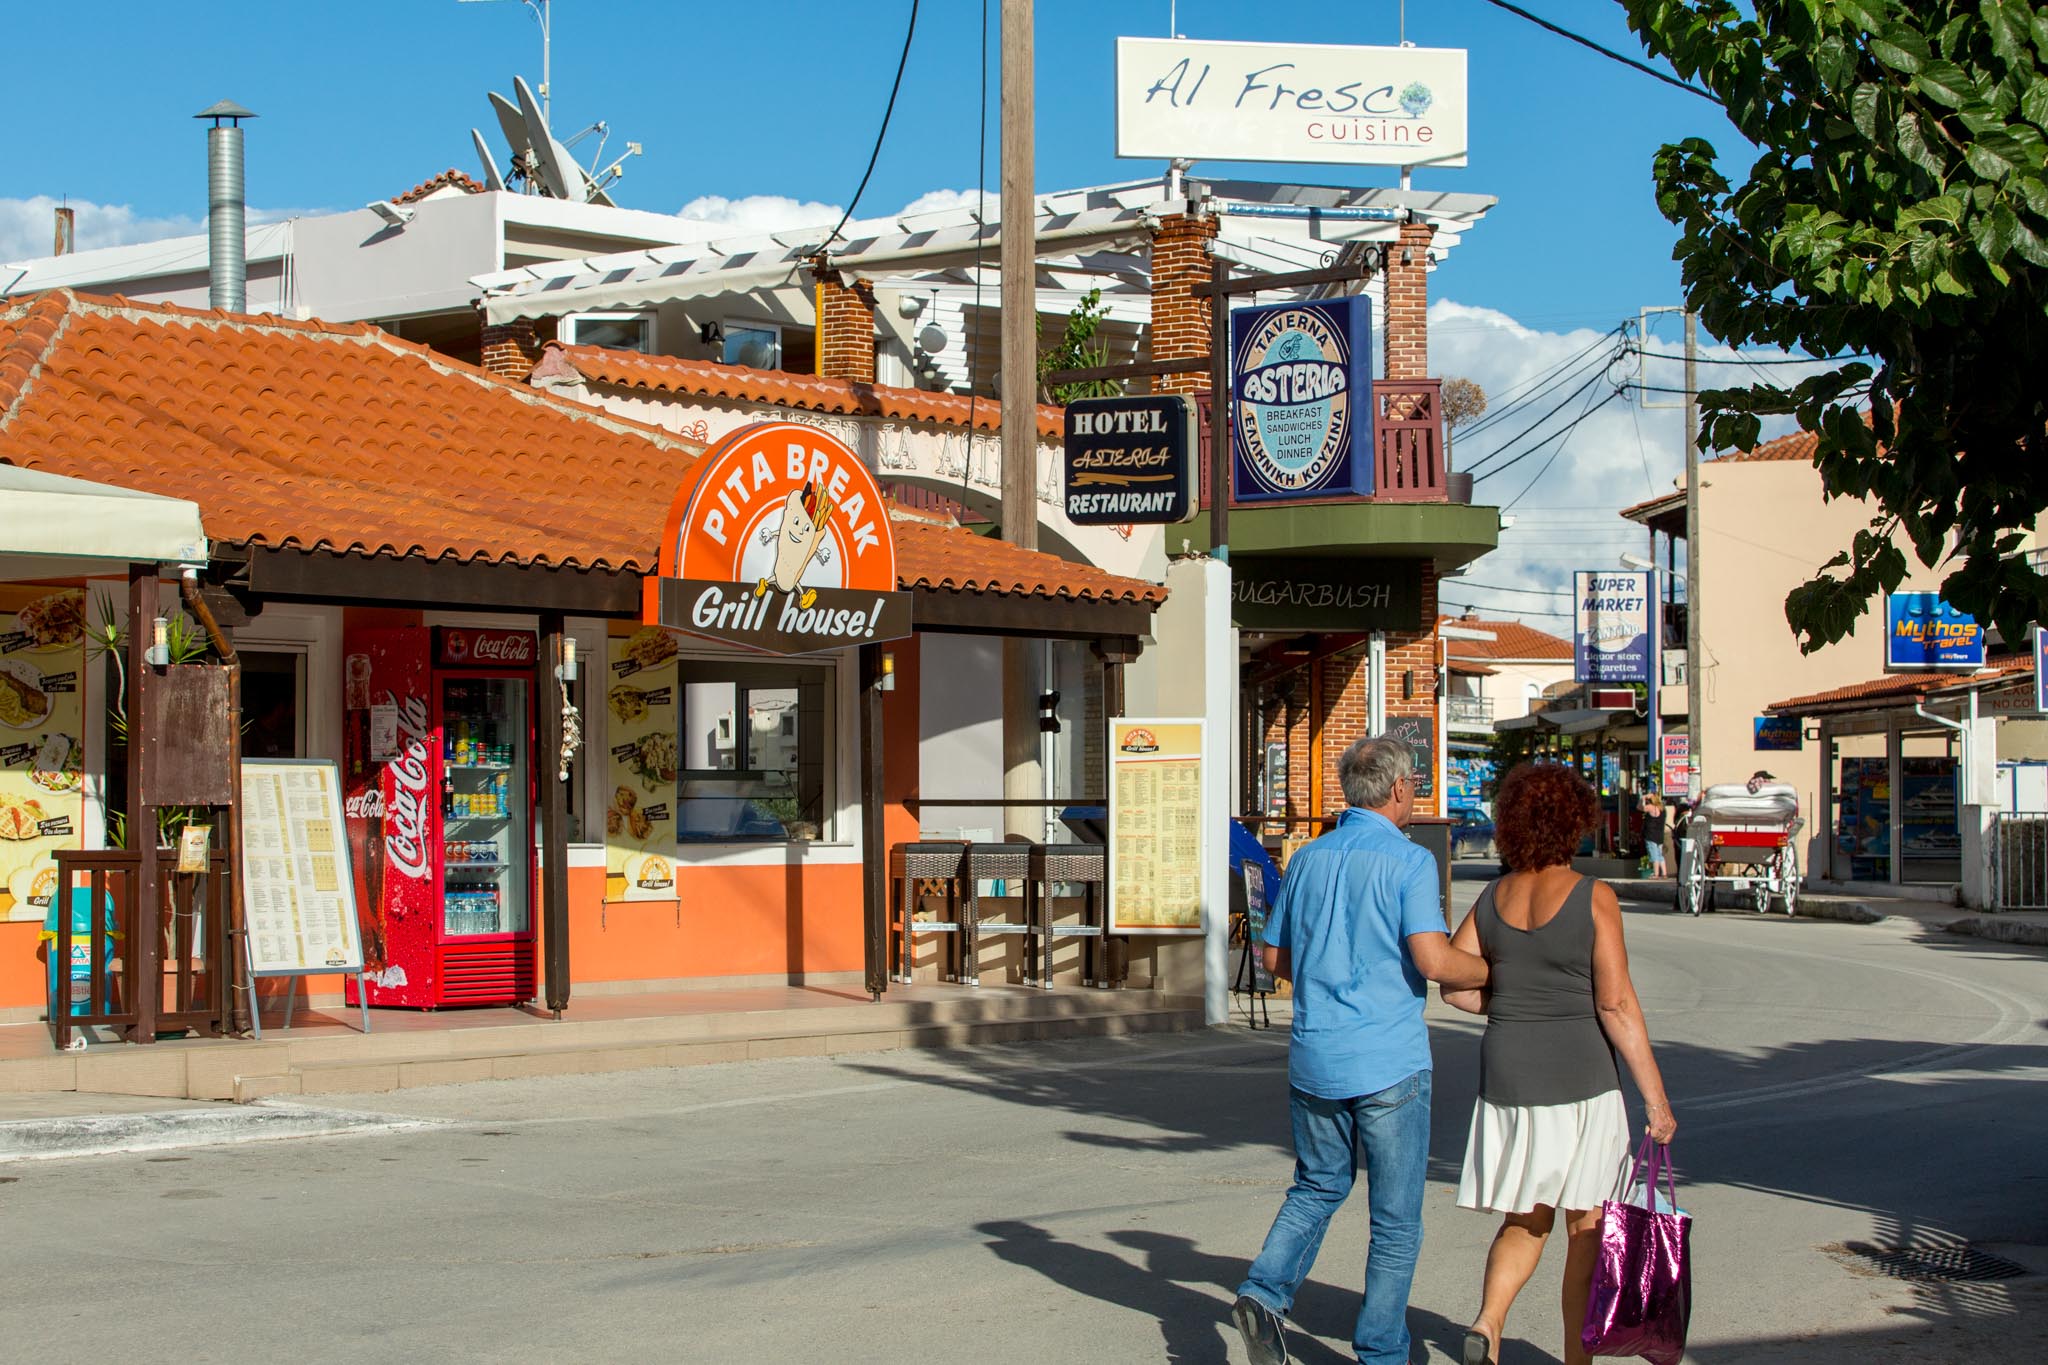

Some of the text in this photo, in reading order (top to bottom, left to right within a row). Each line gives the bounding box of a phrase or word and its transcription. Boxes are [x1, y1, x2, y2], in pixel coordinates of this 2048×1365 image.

[1145, 58, 1210, 107] Al
[1307, 119, 1434, 142] cuisine
[1255, 313, 1329, 353] TAVERNA
[1243, 363, 1346, 403] ASTERIA
[1073, 409, 1168, 435] HOTEL
[1266, 407, 1323, 421] BREAKFAST
[1266, 421, 1323, 434] SANDWICHES
[1278, 434, 1311, 446] LUNCH
[1072, 446, 1172, 469] ASTERIA
[1276, 447, 1313, 460] DINNER
[702, 443, 880, 557] PITA BREAK
[1068, 491, 1177, 515] RESTAURANT
[1588, 578, 1636, 592] SUPER
[692, 585, 886, 638] Grill house!
[1582, 598, 1644, 612] MARKET
[1895, 620, 1979, 643] Mythos
[473, 633, 531, 660] Coca-Cola
[1583, 651, 1642, 663] Liquor store
[1588, 663, 1638, 673] Cigarettes
[1669, 738, 1688, 746] SUPE
[346, 789, 384, 818] ca-Cola
